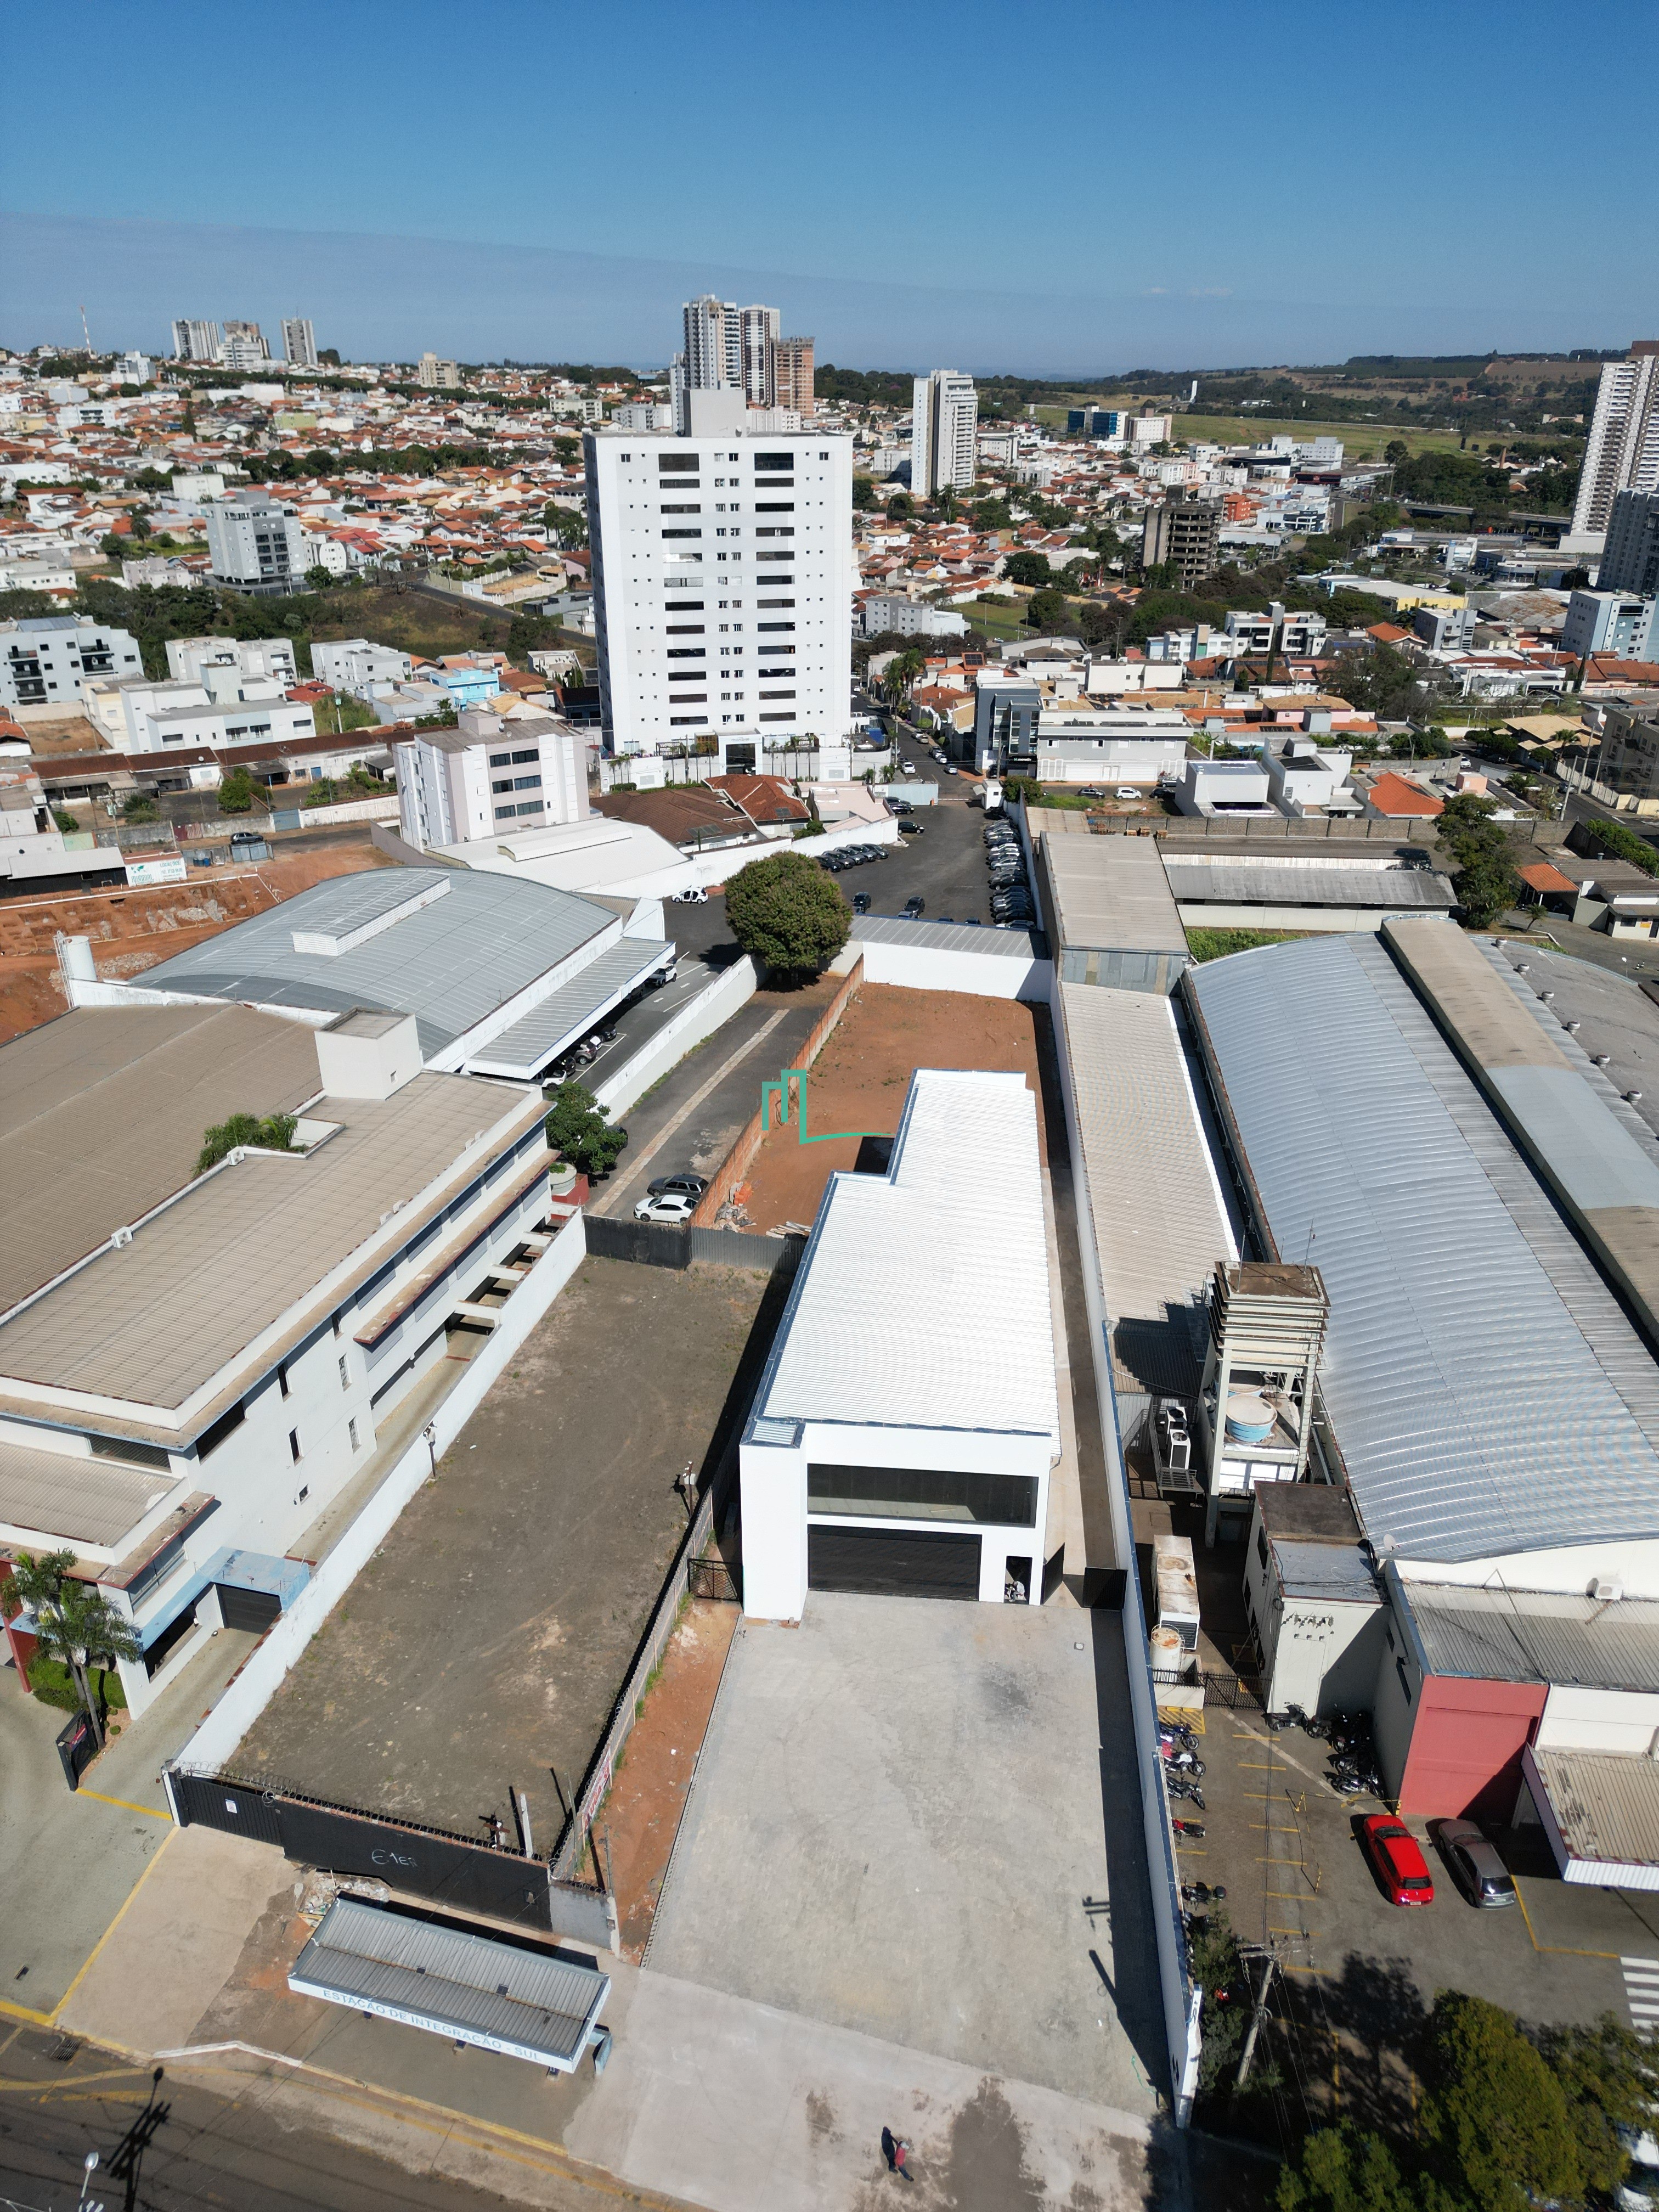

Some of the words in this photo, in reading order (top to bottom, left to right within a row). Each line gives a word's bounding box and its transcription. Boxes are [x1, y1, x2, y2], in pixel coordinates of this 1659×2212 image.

[323, 1990, 386, 2013] ESTAÇÃO
[389, 2008, 408, 2020] DE
[411, 2016, 502, 2049] INTEGRAÇÃO
[515, 2047, 541, 2062] SUL
